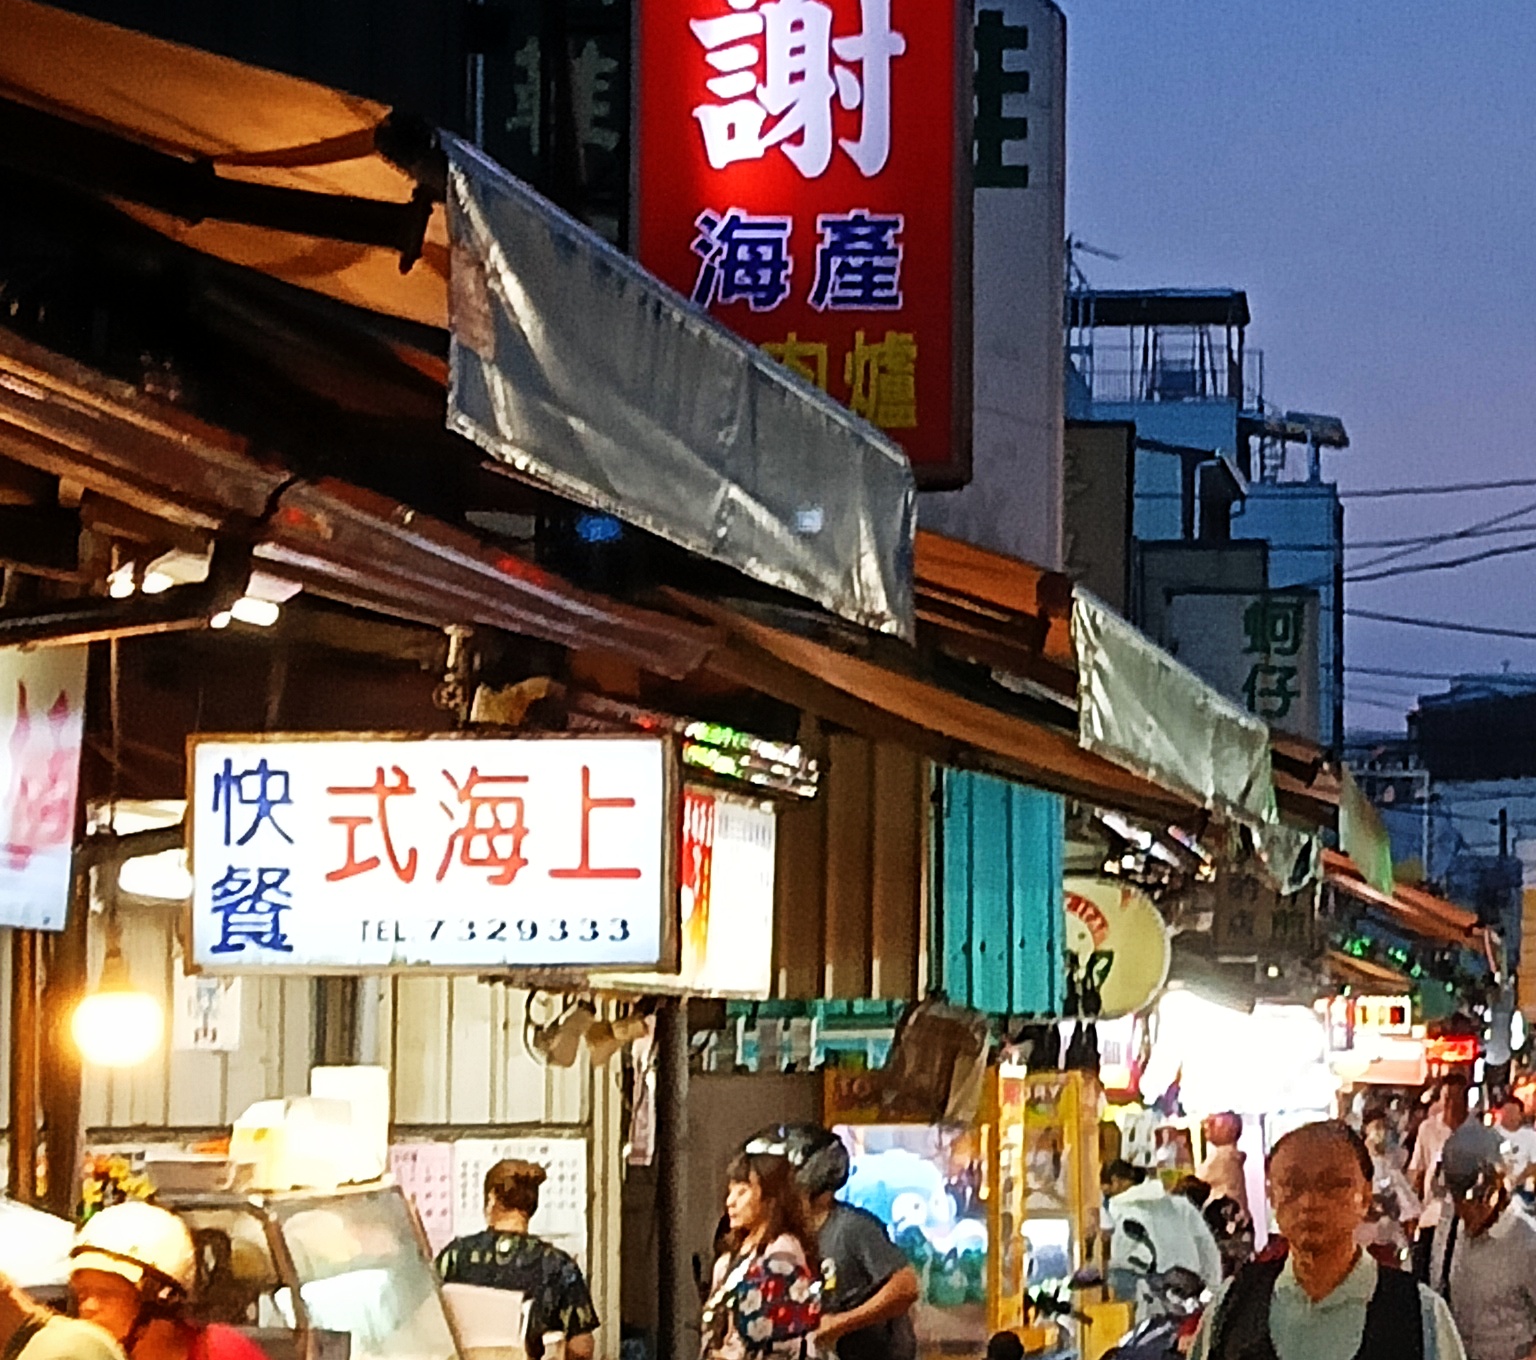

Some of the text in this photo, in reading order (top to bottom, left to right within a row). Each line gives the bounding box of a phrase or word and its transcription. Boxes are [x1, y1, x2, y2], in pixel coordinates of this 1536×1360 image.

[690, 208, 904, 312] 海產
[210, 757, 295, 954] 快餐
[429, 918, 632, 943] 7329333
